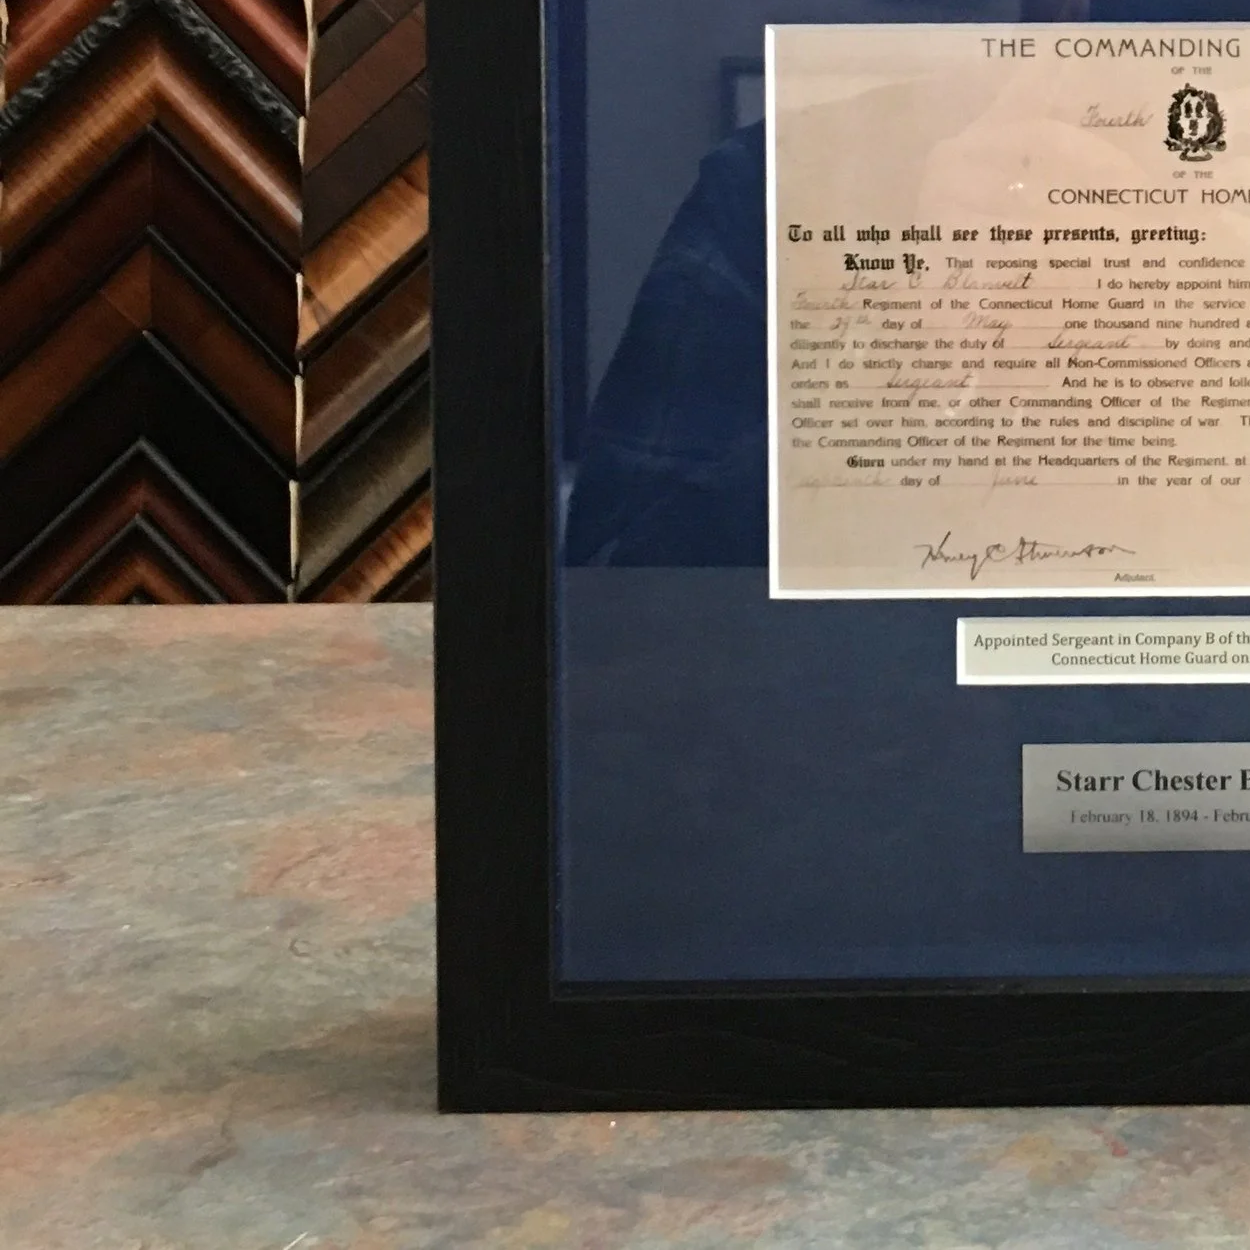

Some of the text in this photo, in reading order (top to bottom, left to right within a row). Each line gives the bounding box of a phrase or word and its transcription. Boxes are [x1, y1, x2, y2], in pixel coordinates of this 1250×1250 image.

[982, 39, 1035, 57] THE
[1055, 38, 1240, 58] COMMANDING
[1171, 66, 1212, 75] OF THE
[1172, 170, 1213, 179] OF THE
[1048, 189, 1188, 205] CONNECTICUT
[788, 224, 1206, 245] To all who shall see these presents, greeting:
[844, 253, 894, 271] Know
[945, 257, 973, 270] That
[986, 258, 1038, 270] reposing
[1048, 257, 1091, 269] special
[1104, 258, 1131, 268] trust
[1142, 257, 1166, 268] and
[1178, 256, 1245, 268] confidence
[1063, 320, 1088, 329] one
[1094, 318, 1150, 329] thousand
[1156, 320, 1183, 329] nine
[1189, 318, 1240, 329] hundred
[791, 435, 811, 448] the
[818, 437, 901, 448] Commanding
[907, 436, 948, 447] Officer
[954, 436, 966, 446] of
[972, 436, 991, 446] the
[997, 435, 1055, 448] Regiment
[1061, 436, 1077, 446] for
[1083, 436, 1103, 446] the
[1108, 436, 1135, 446] time
[974, 634, 1047, 650] Appointed
[1052, 633, 1114, 649] Sergeant
[1118, 634, 1131, 645] in
[1135, 632, 1202, 648] Company
[1206, 632, 1215, 644] B
[1219, 631, 1233, 644] of
[1052, 653, 1136, 666] Connecticut
[1140, 652, 1181, 665] Home
[1185, 651, 1228, 664] Guard
[1232, 654, 1250, 664] on
[1057, 770, 1124, 791] Starr
[1132, 770, 1232, 791] Chester
[1071, 810, 1131, 826] February
[1167, 809, 1198, 822] 1894
